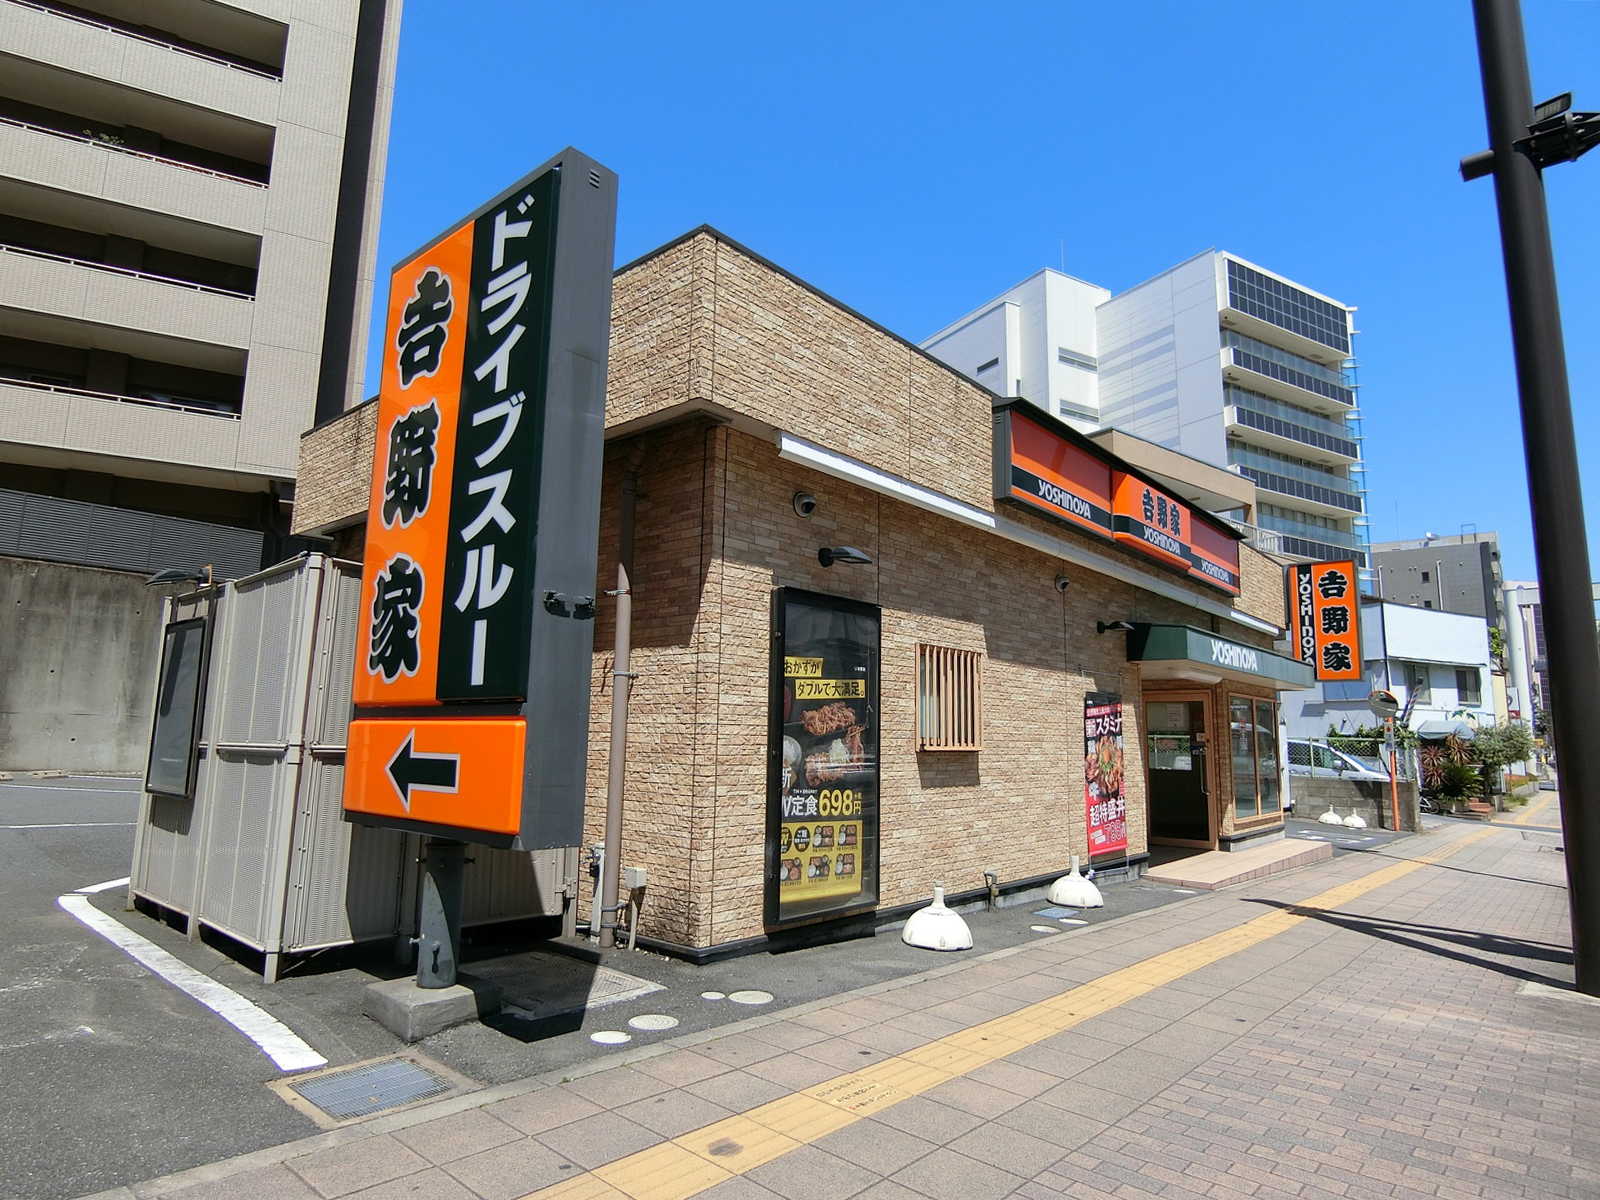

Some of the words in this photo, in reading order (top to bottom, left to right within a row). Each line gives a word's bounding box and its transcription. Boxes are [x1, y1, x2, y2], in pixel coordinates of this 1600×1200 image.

[454, 193, 535, 688] ドライブスルー
[1037, 478, 1092, 520] YOSHINOYA
[1143, 525, 1182, 556] YOSHINOYA
[1200, 557, 1230, 583] YOSHINOYA
[1210, 639, 1259, 672] YOSHINOYA
[797, 681, 865, 697] ダブルで大満足。
